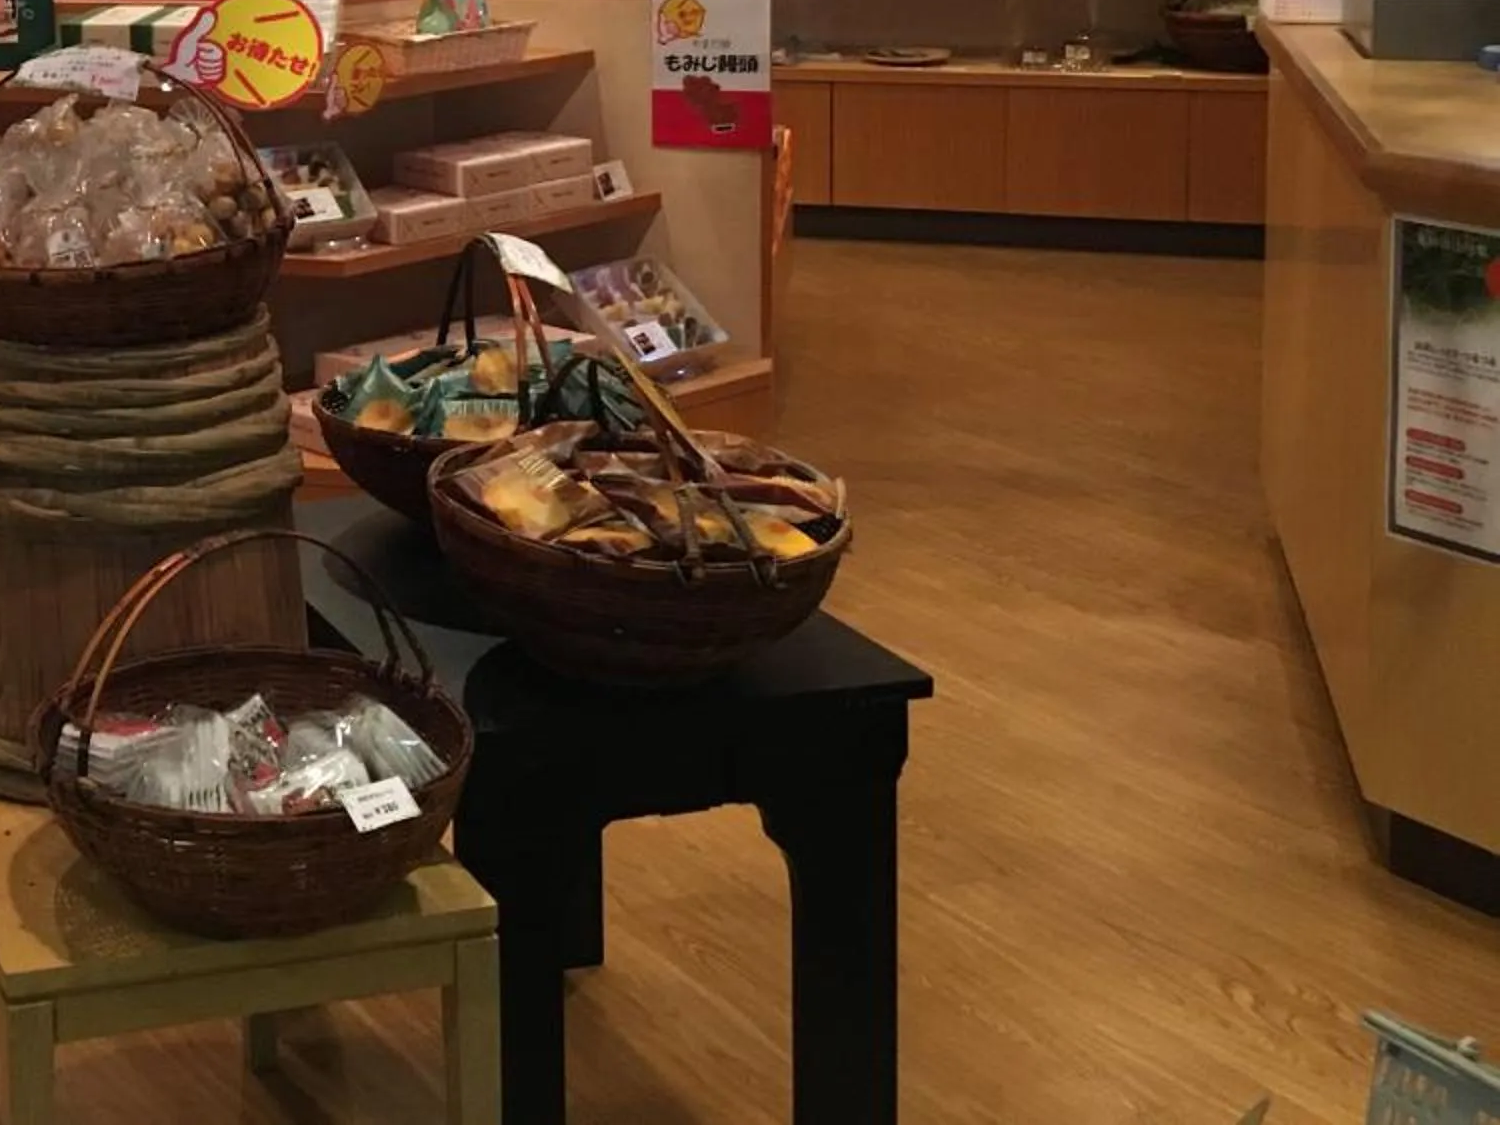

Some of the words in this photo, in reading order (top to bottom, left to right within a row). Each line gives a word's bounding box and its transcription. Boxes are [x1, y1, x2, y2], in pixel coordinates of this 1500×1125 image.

[664, 54, 759, 74] もみじ饅頭
